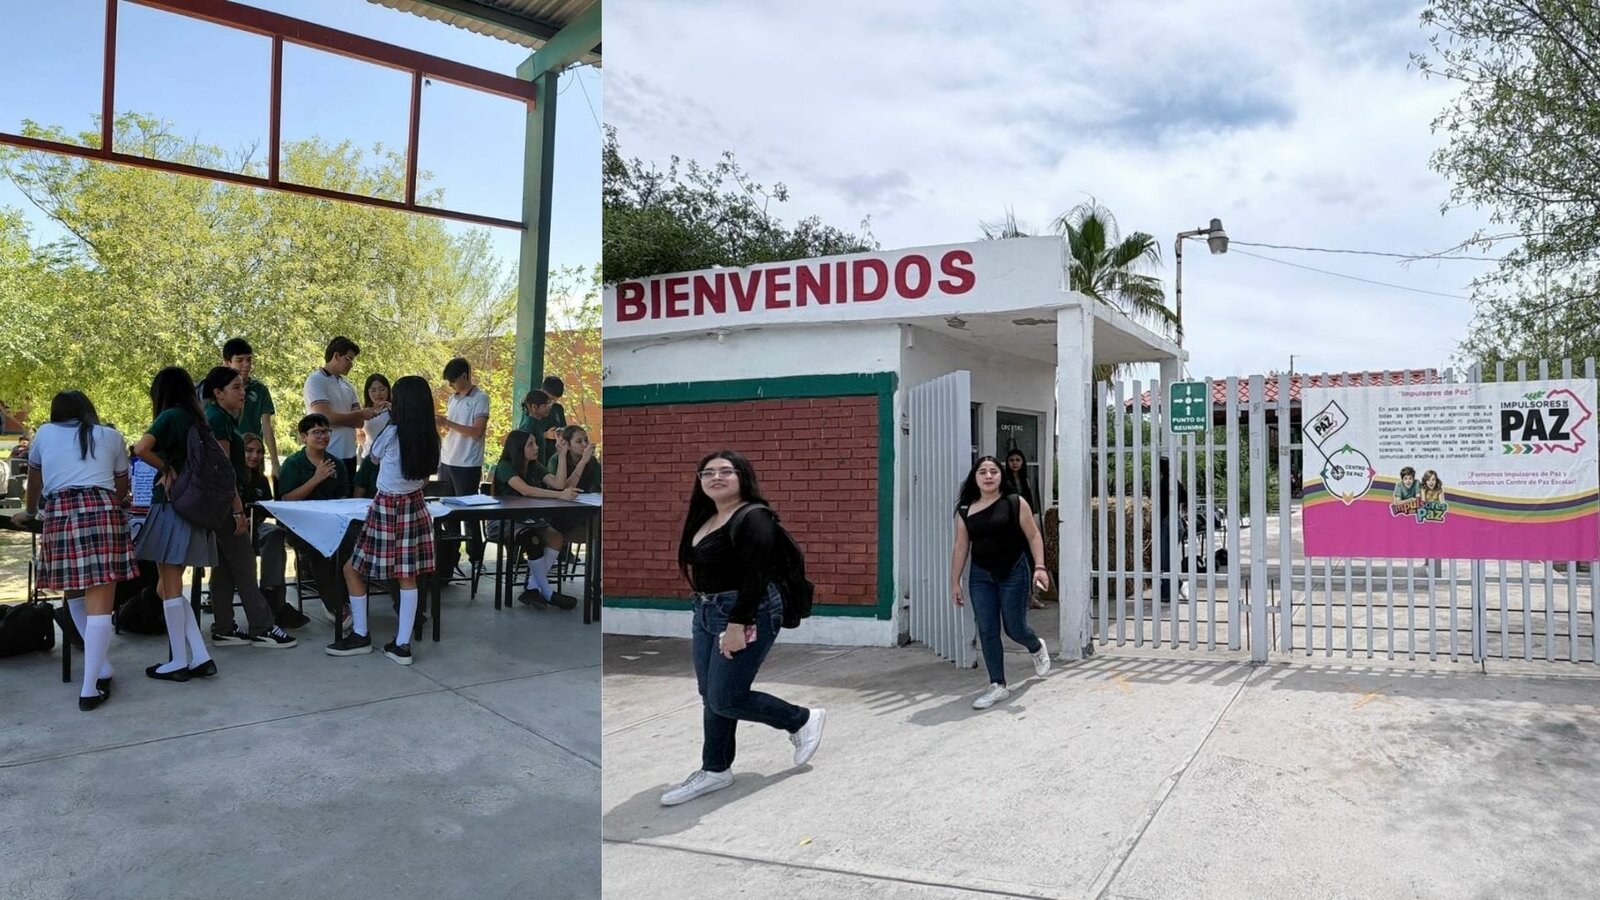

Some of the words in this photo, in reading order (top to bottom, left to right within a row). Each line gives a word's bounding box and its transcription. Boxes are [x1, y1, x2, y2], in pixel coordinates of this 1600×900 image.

[616, 250, 976, 322] BIENVENIDOS
[1500, 400, 1561, 409] IMPULSORES
[1314, 415, 1334, 436] PAZ
[1501, 408, 1570, 442] PAZ
[1391, 496, 1447, 514] Impulsores
[1417, 507, 1443, 522] Paz
